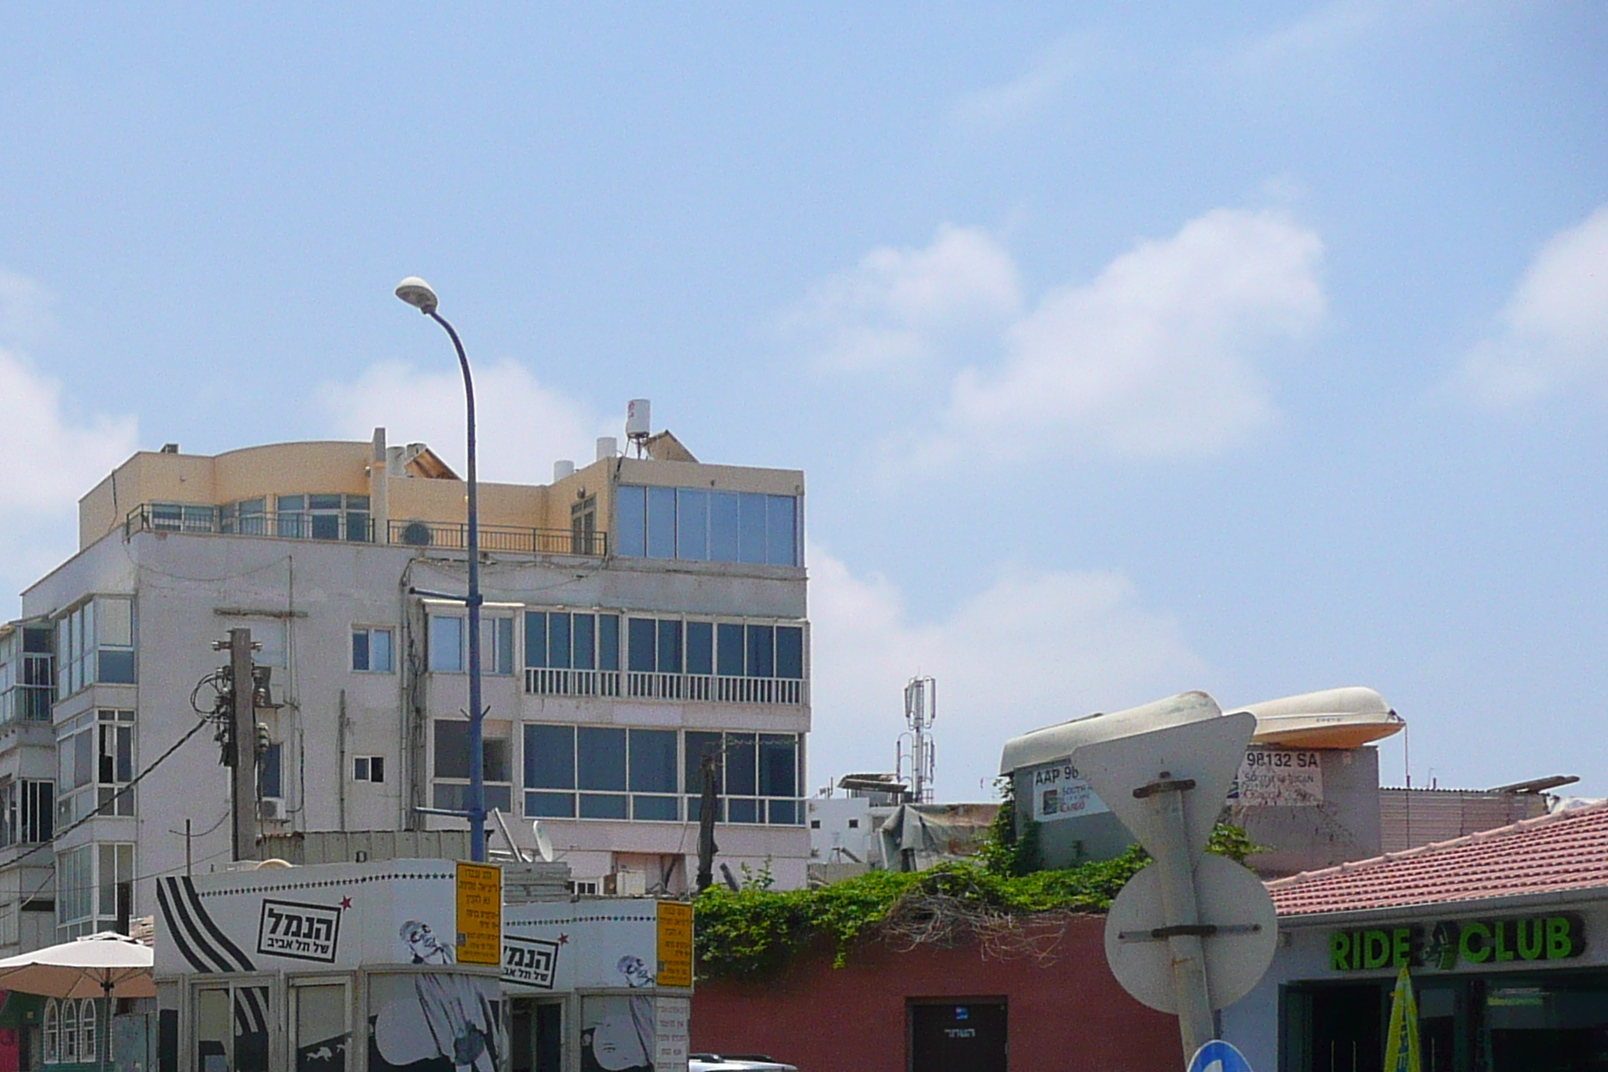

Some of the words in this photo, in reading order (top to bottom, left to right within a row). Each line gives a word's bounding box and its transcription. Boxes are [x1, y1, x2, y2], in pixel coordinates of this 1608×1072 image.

[1297, 753, 1318, 768] SA
[1035, 768, 1060, 786] AAP
[267, 908, 333, 942] הנמל
[267, 937, 293, 949] אביב
[296, 939, 310, 952] תל
[313, 941, 330, 954] של
[1330, 928, 1411, 970] RIDE
[1459, 917, 1572, 963] CLUB
[503, 966, 516, 977] אב
[518, 968, 531, 979] תל
[534, 970, 549, 982] של
